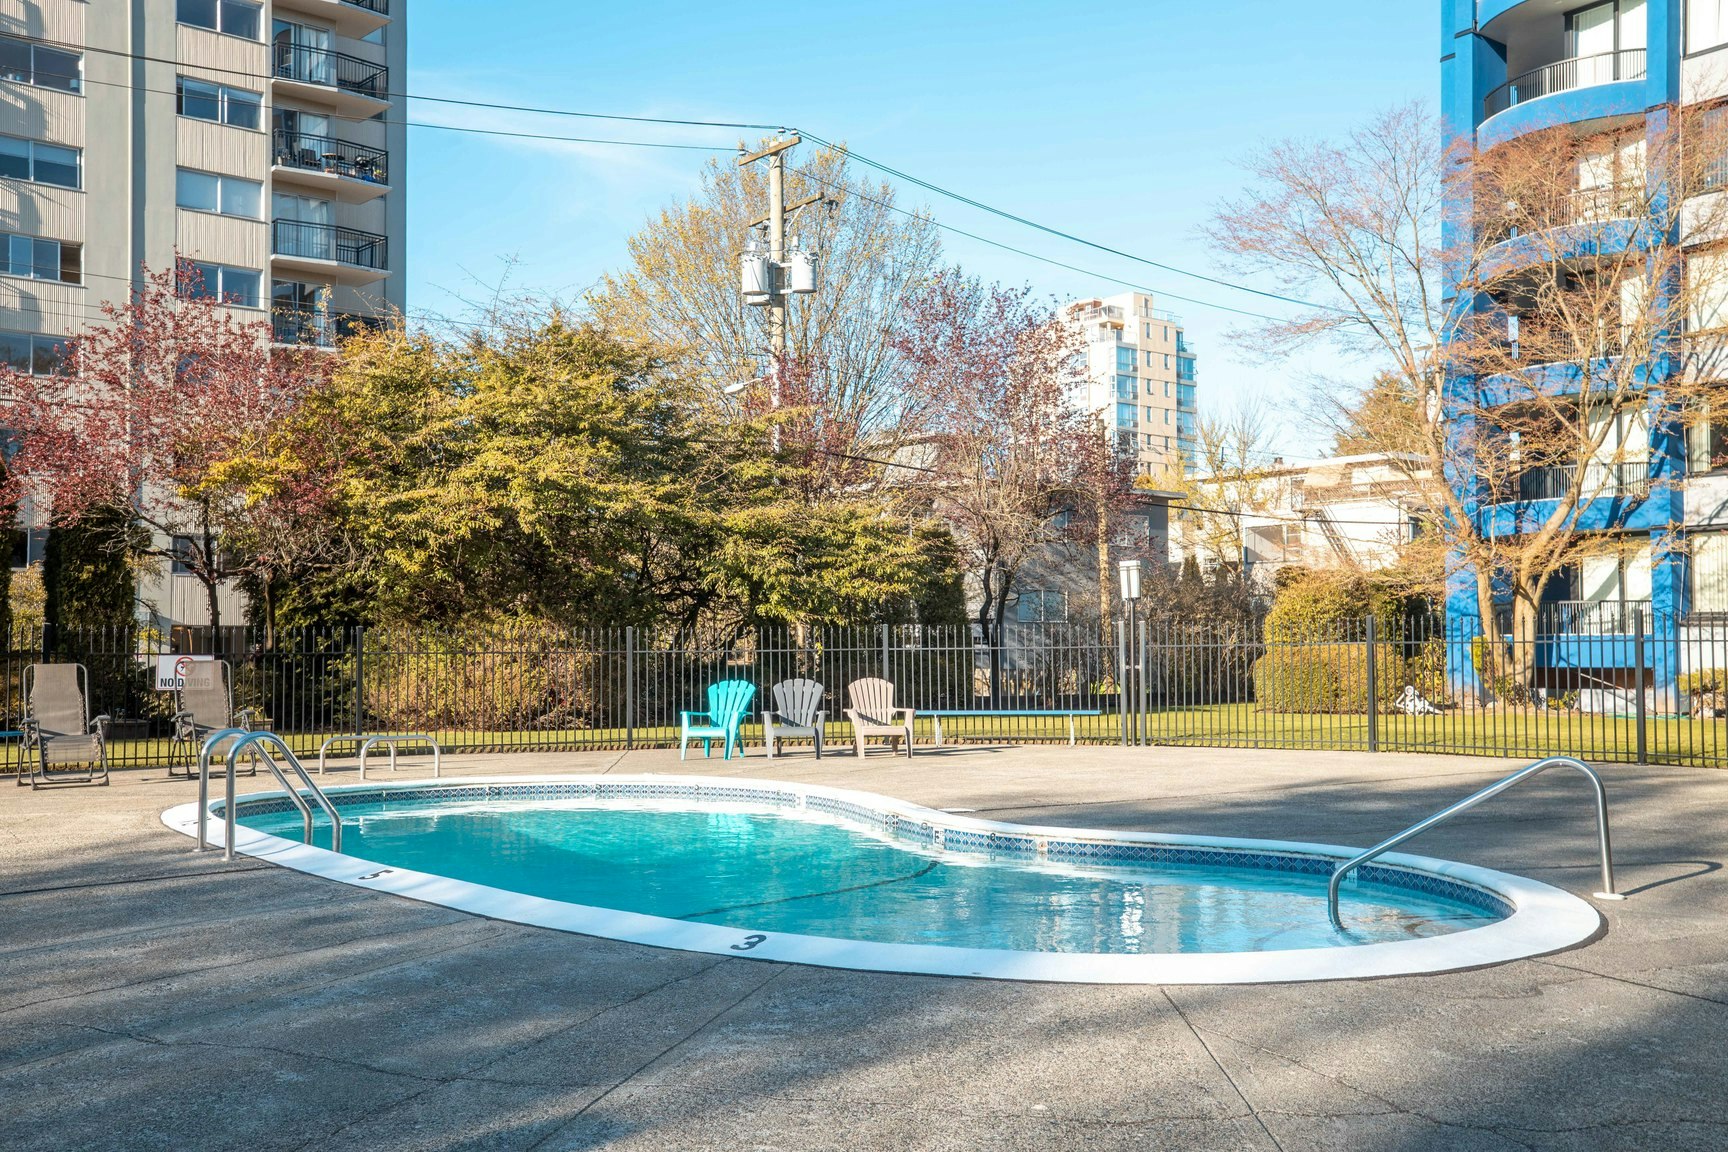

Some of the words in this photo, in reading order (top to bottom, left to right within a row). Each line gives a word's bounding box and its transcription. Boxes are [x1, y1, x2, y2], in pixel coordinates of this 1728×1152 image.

[160, 677, 174, 687] NO
[177, 677, 210, 687] DVING
[730, 934, 767, 951] 3
